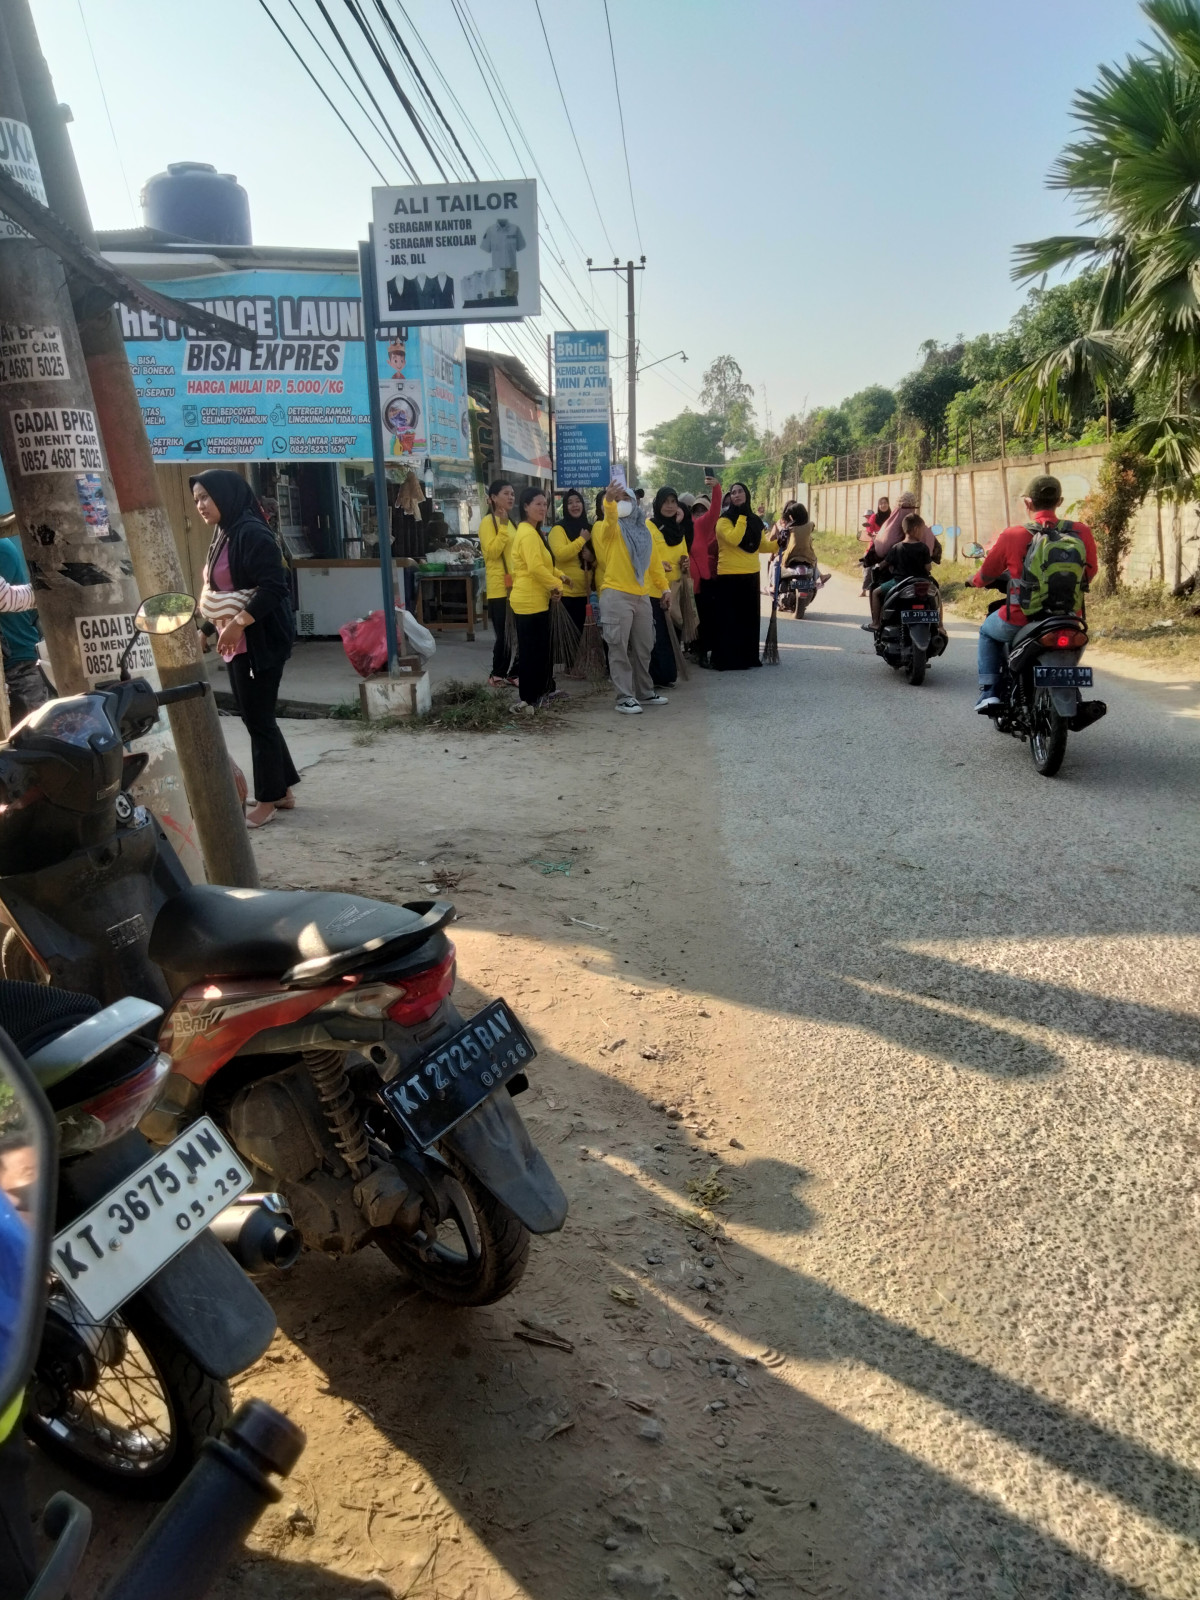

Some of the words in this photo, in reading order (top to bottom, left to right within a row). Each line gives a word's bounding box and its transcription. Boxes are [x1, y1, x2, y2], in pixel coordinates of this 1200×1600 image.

[393, 196, 429, 215] ALI
[436, 192, 518, 213] TAILOR
[388, 220, 433, 234] SERAGAM
[435, 218, 472, 232] KANTOR
[389, 236, 434, 250] SERAGAM
[435, 234, 477, 248] SEKOLAH
[390, 254, 409, 266] JAS,
[410, 253, 426, 265] DLL
[0, 343, 27, 358] ENIT
[32, 342, 60, 354] CAIR
[556, 341, 605, 357] BRILink
[137, 356, 156, 365] BISA
[187, 343, 241, 371] BISA
[249, 343, 341, 371] EXPRES
[9, 357, 34, 379] 4687
[37, 356, 65, 377] 5025
[142, 366, 175, 375] BONEKA
[556, 366, 587, 376] KEMBAR
[588, 365, 607, 375] CELL
[187, 380, 225, 394] HARGA
[229, 379, 262, 393] MULAI
[266, 379, 283, 393] RP.
[286, 379, 344, 395] 5.000/KG
[556, 377, 580, 389] MINI
[583, 376, 607, 388] ATM
[145, 388, 175, 397] SEPATU
[146, 407, 160, 416] TAS
[201, 407, 218, 416] CUCI
[220, 406, 256, 415] BEDCOVER
[325, 406, 352, 415] RAMAH
[14, 410, 59, 434] GADAI
[61, 410, 94, 432] BPKB
[144, 416, 165, 425] HELM
[201, 415, 232, 425] SELIMUT
[239, 415, 268, 424] HANDUK
[288, 415, 334, 424] LINGKUNGAN
[336, 415, 356, 424] TIDAK
[18, 437, 31, 448] 30
[34, 434, 72, 447] MENIT
[75, 434, 98, 446] CAIR
[153, 437, 184, 446] SETRIKA
[206, 437, 264, 446] MENGGUNAKAN
[289, 436, 305, 445] BISA
[307, 436, 329, 445] ANTAR
[330, 436, 357, 445] JEMPUT
[239, 446, 255, 454] UAP
[289, 445, 308, 454] 0822
[21, 449, 48, 472] 0852
[51, 448, 77, 469] 4687
[80, 448, 101, 468] 5025
[80, 616, 123, 640] GADAI
[83, 642, 97, 653] 30
[86, 653, 114, 675] 0852
[393, 1074, 430, 1115] KT
[424, 1034, 482, 1090] 2725
[473, 1009, 512, 1050] BAV
[56, 1223, 105, 1280] KT
[107, 1161, 181, 1235] 3675
[176, 1127, 223, 1175] MN
